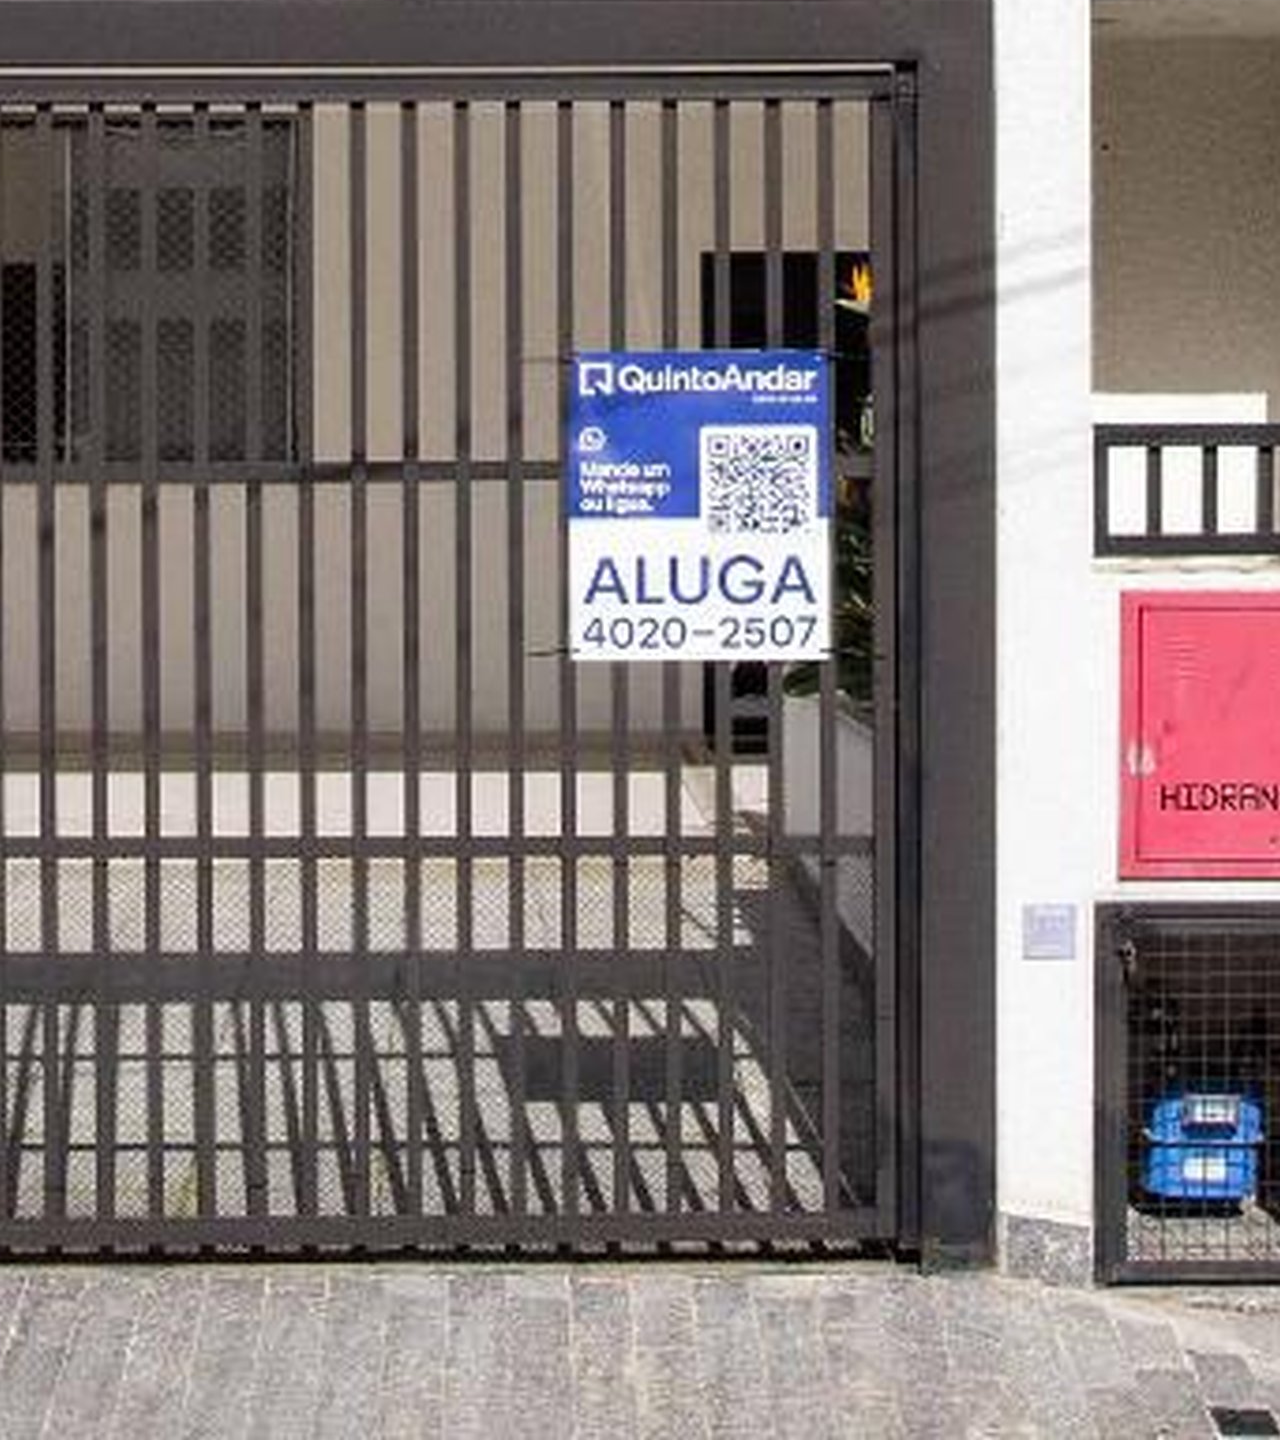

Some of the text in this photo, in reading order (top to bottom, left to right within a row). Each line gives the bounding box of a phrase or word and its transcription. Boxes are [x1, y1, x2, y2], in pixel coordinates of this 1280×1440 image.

[619, 363, 818, 394] QuintoAndar
[583, 554, 817, 605] ALUGA
[582, 616, 818, 650] 4020-2507
